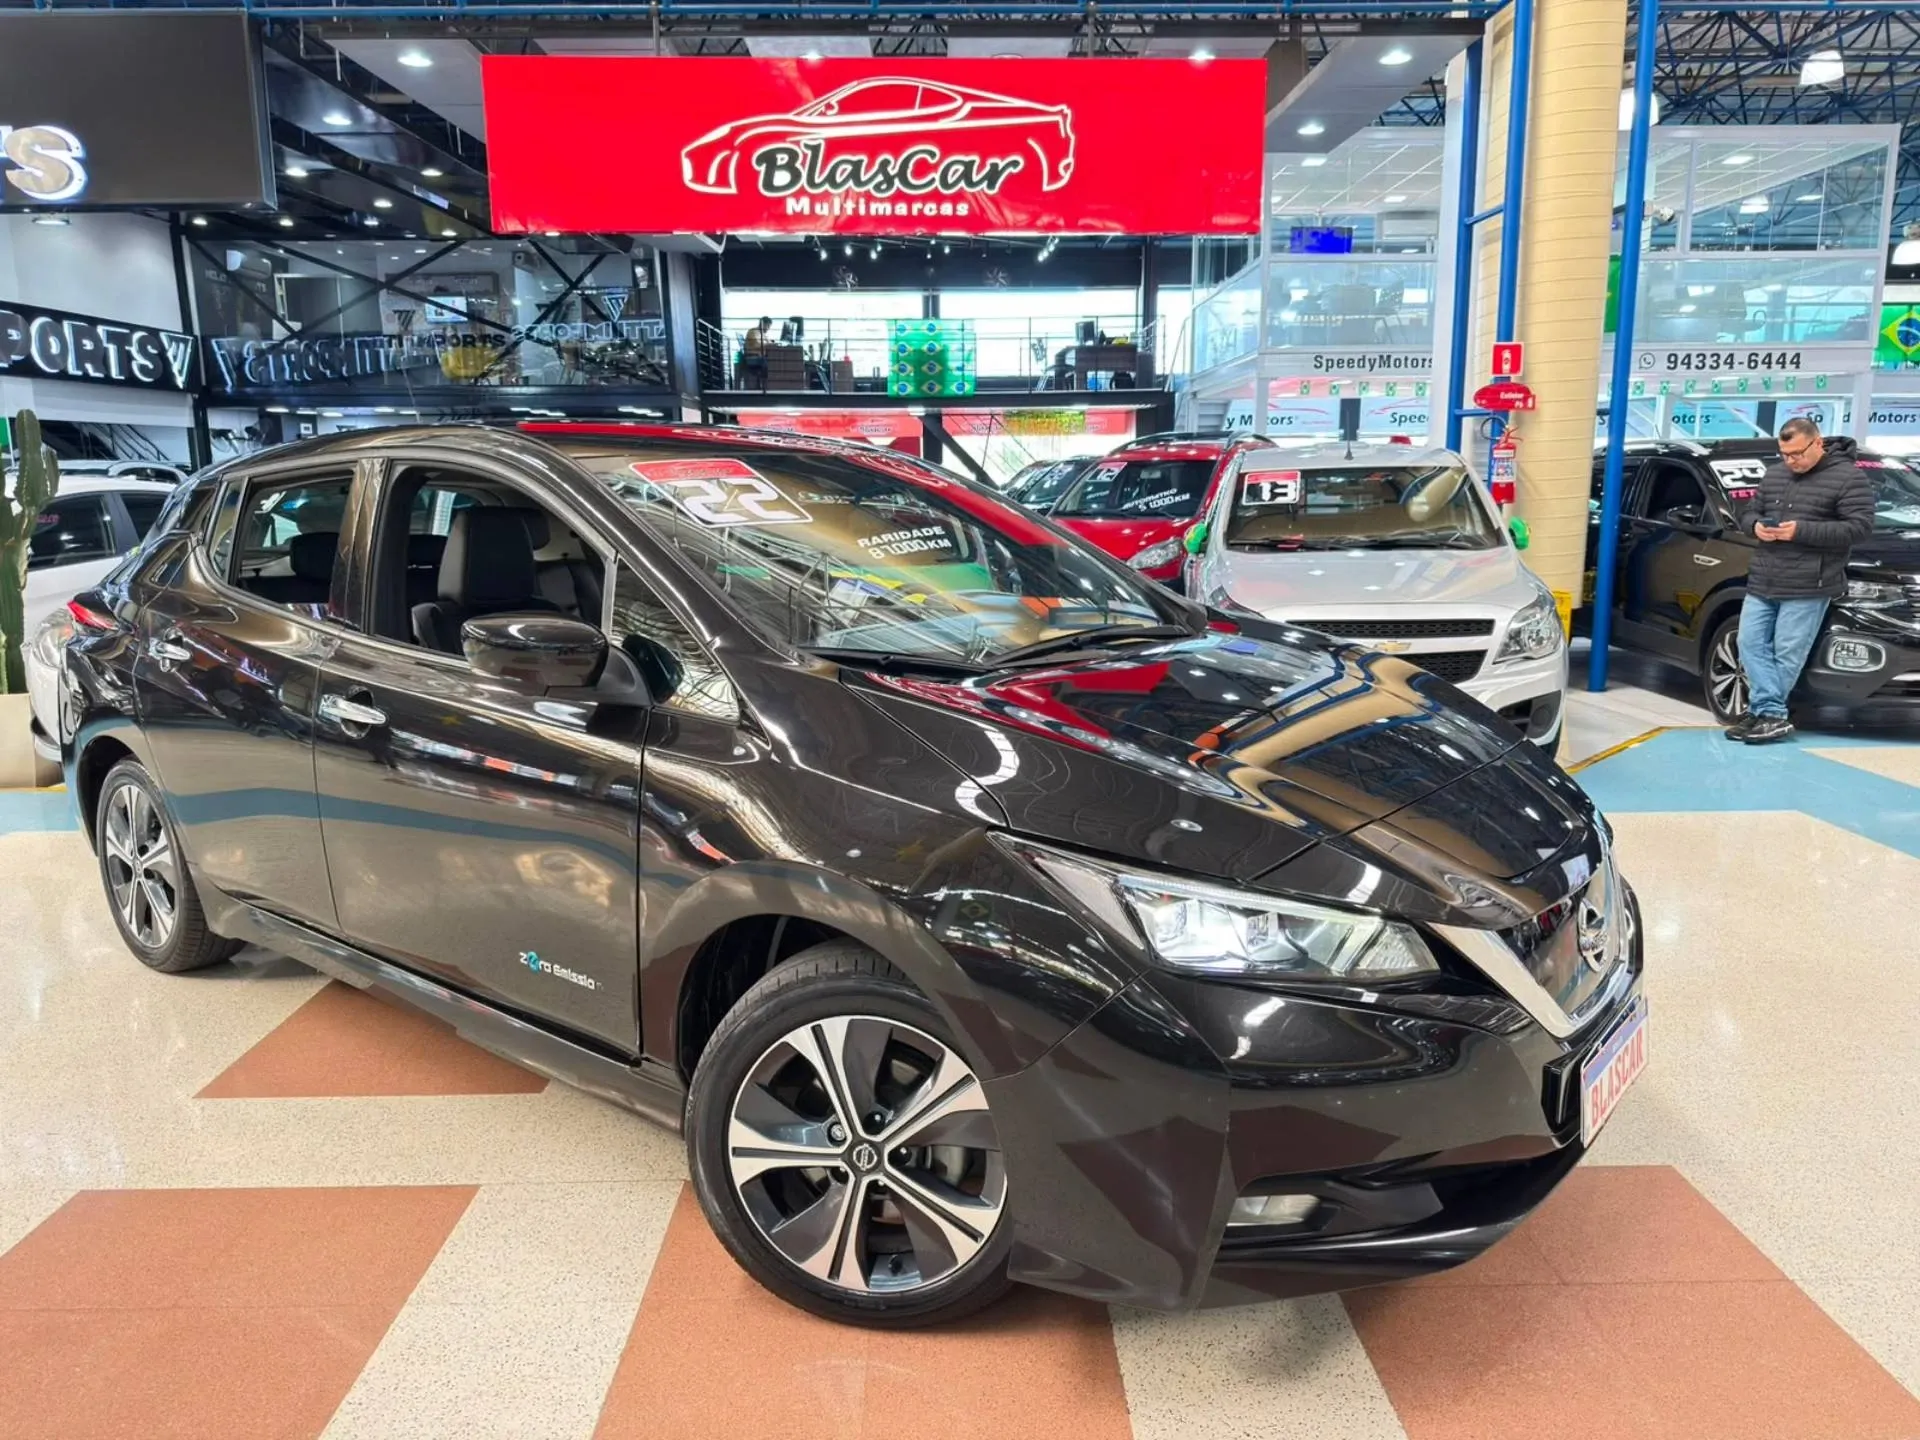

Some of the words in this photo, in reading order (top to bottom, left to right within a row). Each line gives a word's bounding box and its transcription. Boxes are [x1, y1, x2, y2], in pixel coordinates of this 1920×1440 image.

[755, 141, 1023, 196] BlasCar
[785, 197, 969, 216] Multimarcas
[1666, 352, 1801, 370] 94334-6444
[667, 478, 802, 522] 22
[1728, 488, 1758, 499] TET
[857, 526, 946, 548] RARIDADE
[1591, 1026, 1644, 1128] BLASCAR
